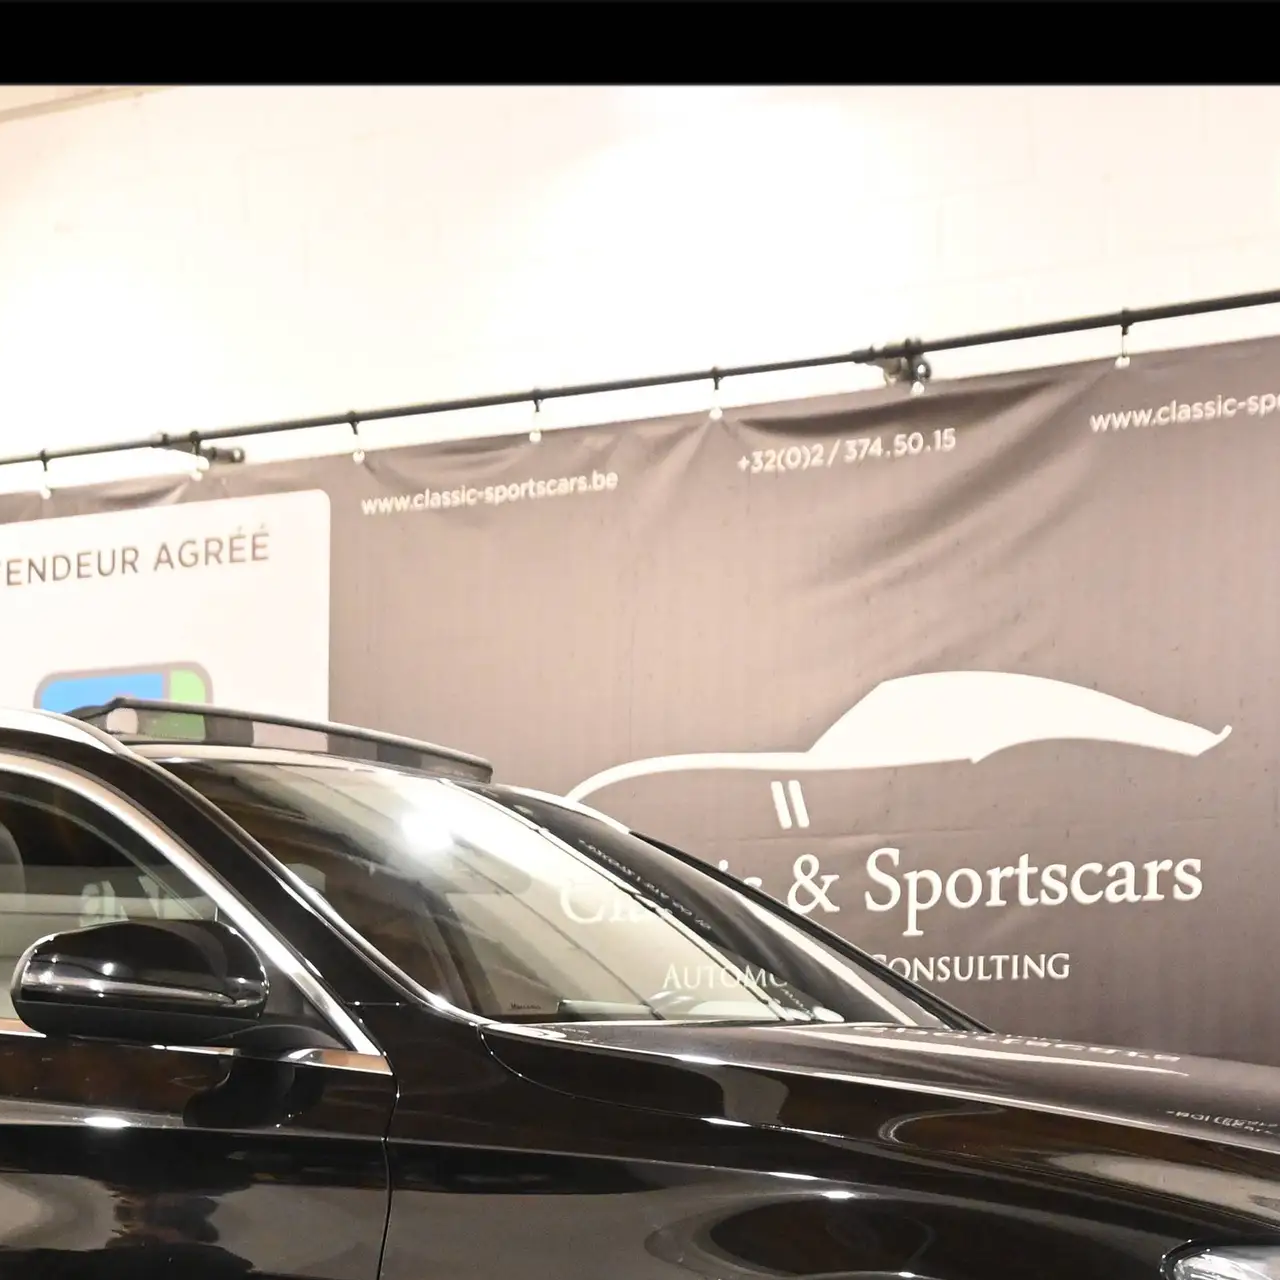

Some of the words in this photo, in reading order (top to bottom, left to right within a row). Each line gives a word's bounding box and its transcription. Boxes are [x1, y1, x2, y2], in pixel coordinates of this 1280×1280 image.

[843, 428, 957, 463] 374.50.15
[361, 470, 619, 515] www.classic-sportscars.be
[153, 523, 270, 572] AGRÉÉ
[786, 853, 840, 914] &
[863, 847, 1204, 937] Sportscars
